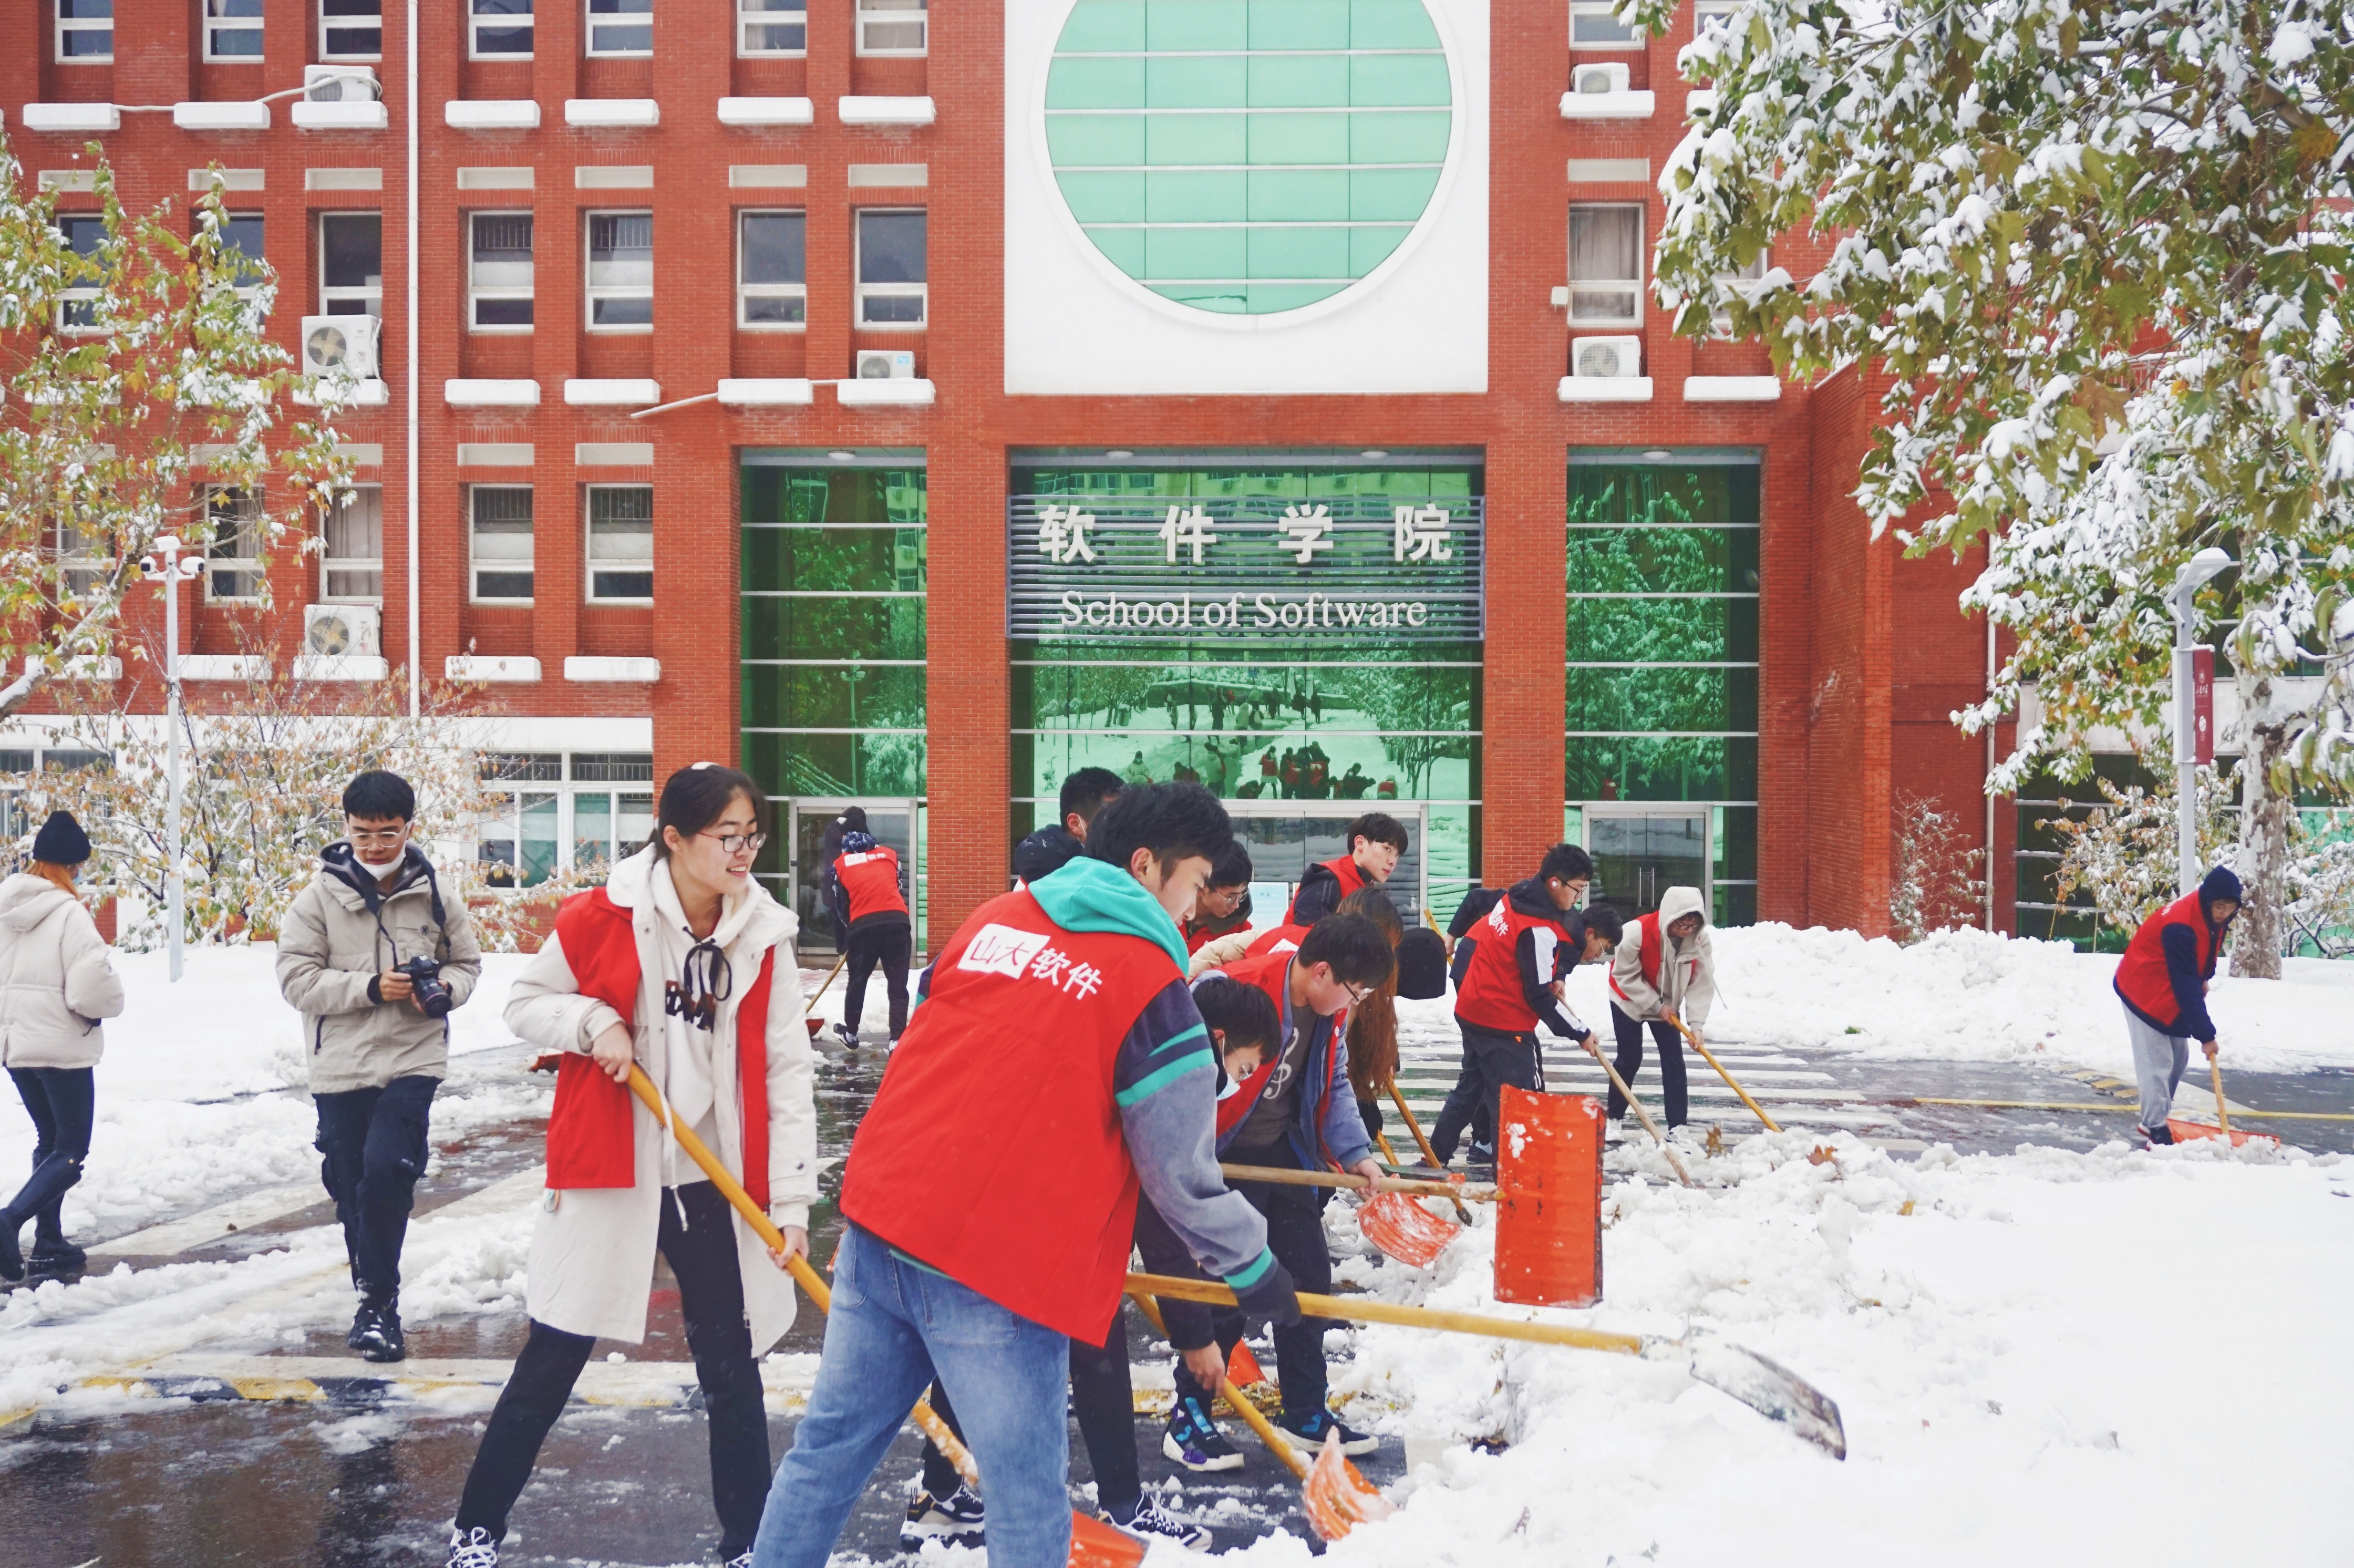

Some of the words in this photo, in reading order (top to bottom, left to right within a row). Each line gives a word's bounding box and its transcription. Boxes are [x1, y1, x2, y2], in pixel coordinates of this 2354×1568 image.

[1038, 503, 1452, 563] 软件学院
[1061, 590, 1192, 627] School
[1203, 592, 1246, 627] of
[1254, 592, 1427, 628] Software
